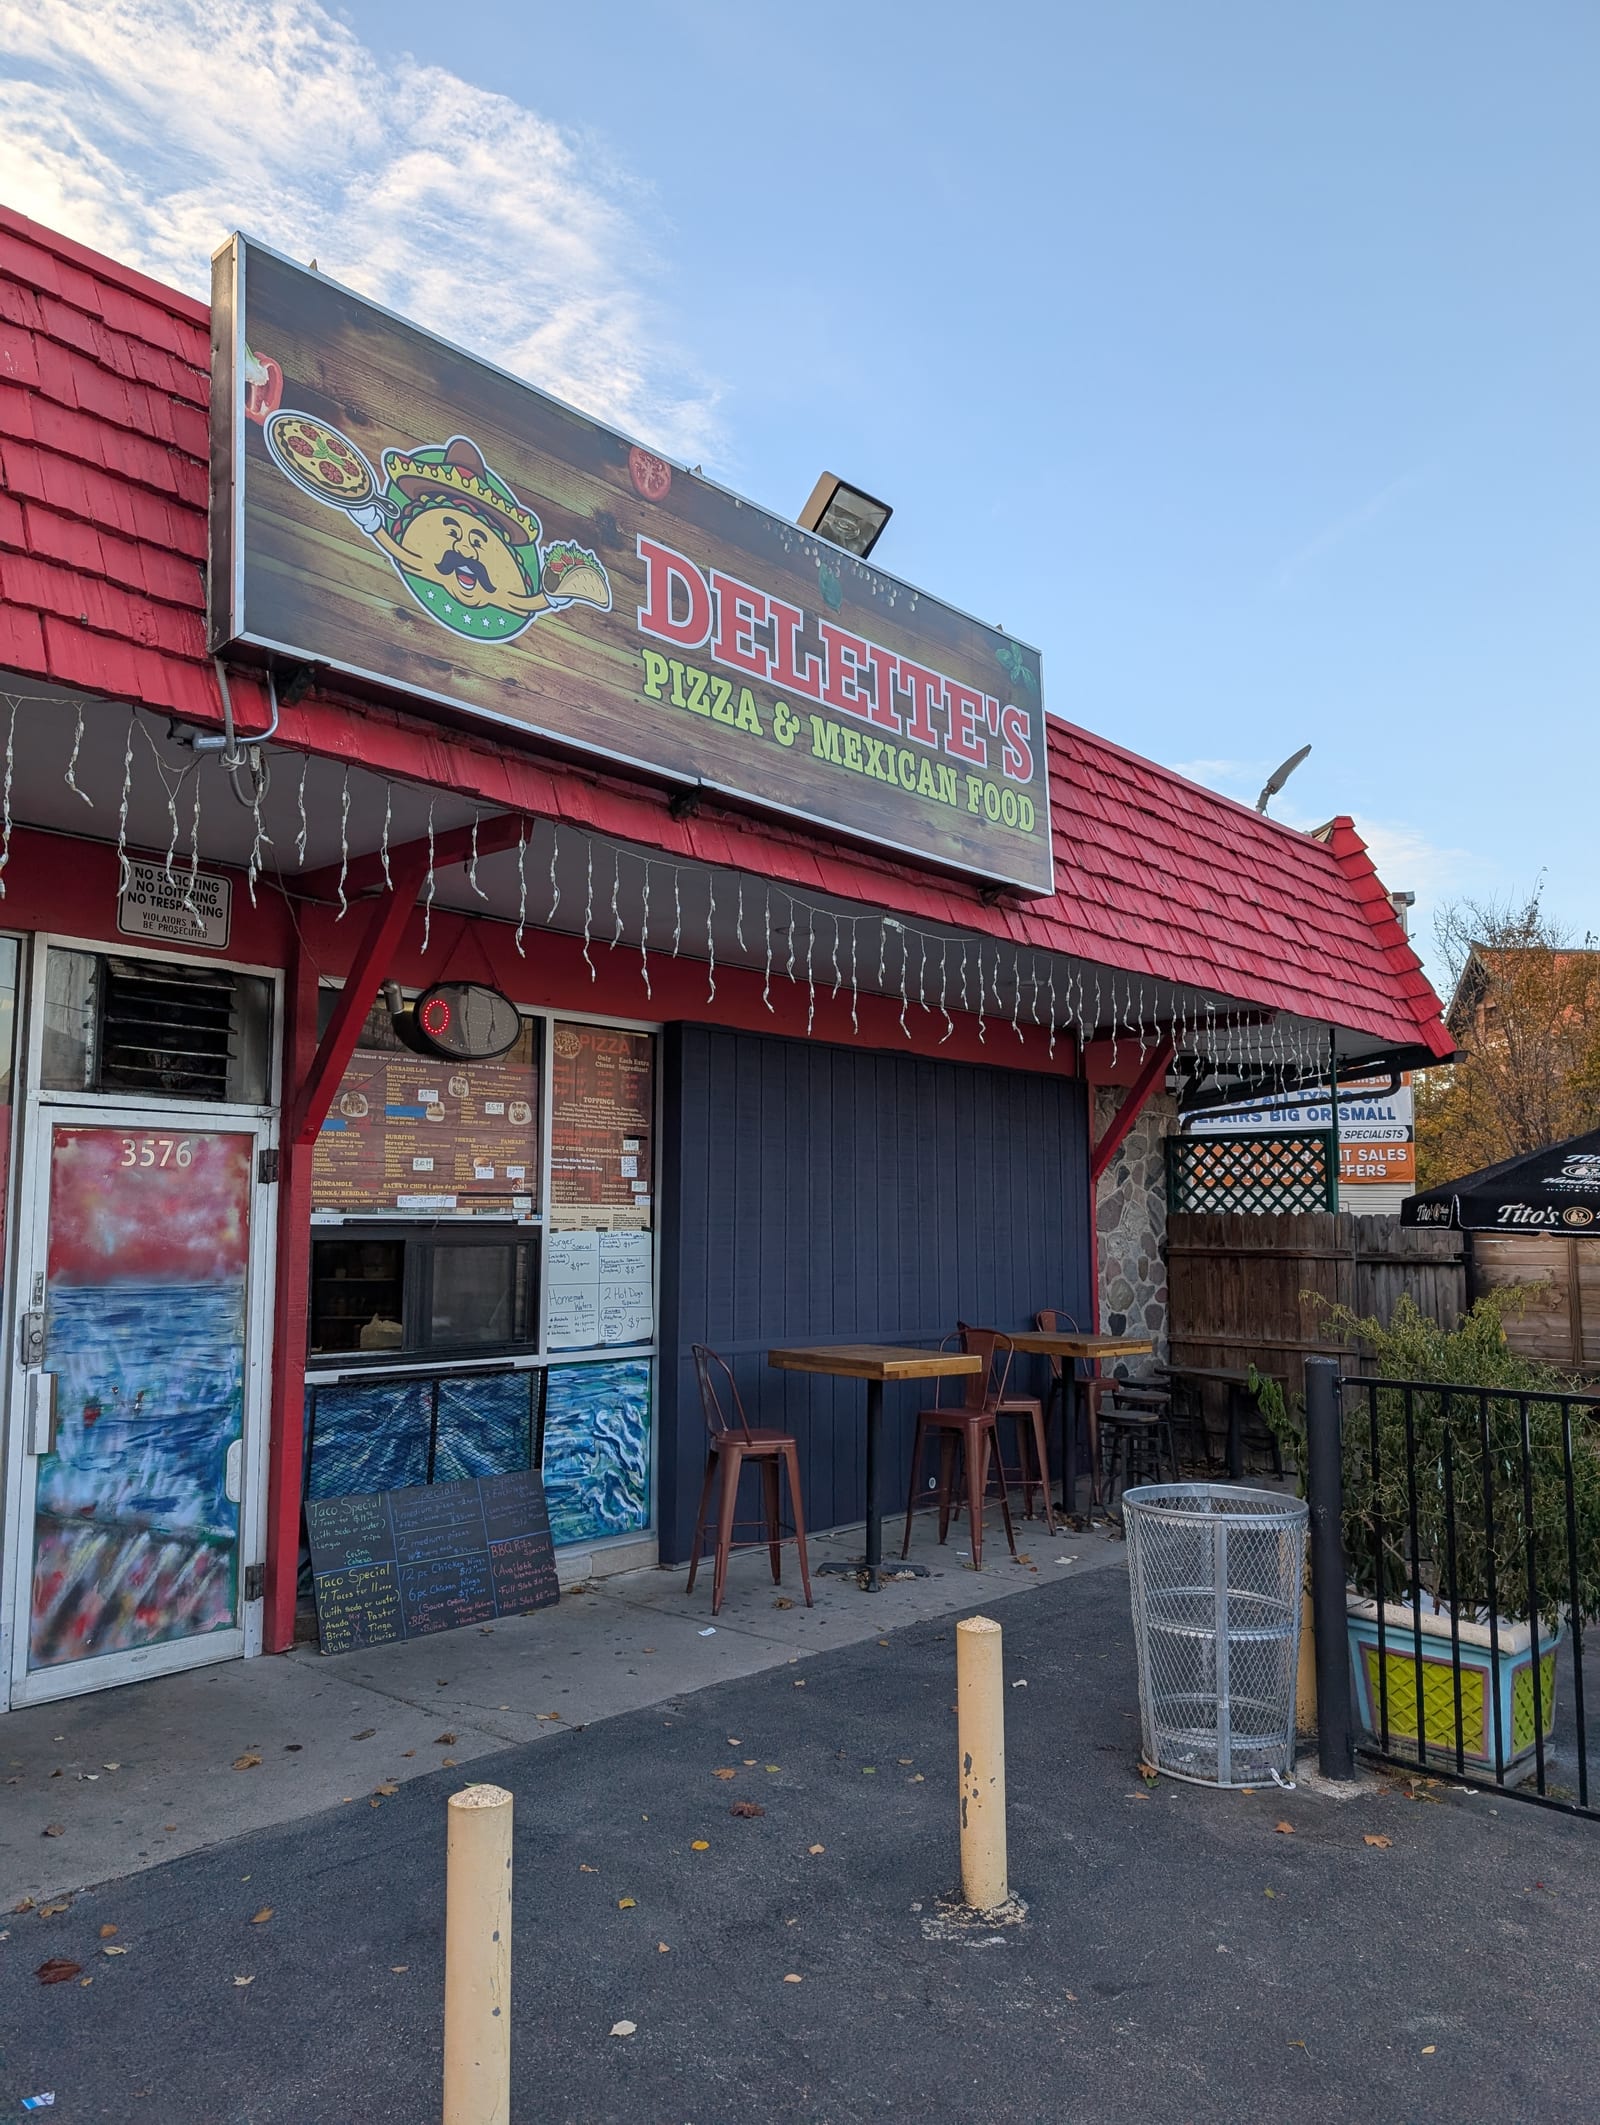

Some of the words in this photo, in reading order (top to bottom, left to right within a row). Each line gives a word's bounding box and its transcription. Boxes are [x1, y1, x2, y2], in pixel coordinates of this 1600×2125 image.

[637, 533, 1035, 784] DELEITE'S
[640, 648, 764, 737] PIZZA
[772, 701, 800, 747] &
[809, 713, 959, 808] MEXICAN
[965, 773, 1036, 833] FOOD
[135, 867, 153, 880] NO
[157, 871, 220, 893] SOLICTING
[136, 880, 154, 893] NO
[127, 892, 146, 904] NO
[143, 911, 186, 926] VIOLATORS
[191, 920, 208, 930] WL
[143, 920, 153, 929] BE
[158, 923, 207, 938] PROSECUTED
[580, 1034, 631, 1055] PIZZA
[583, 1096, 615, 1105] TOPPINGS
[1270, 1108, 1300, 1122] BIG
[1307, 1107, 1332, 1121] OR
[1339, 1106, 1396, 1121] SMALL
[1344, 1129, 1404, 1139] SPECIALISTS
[121, 1139, 192, 1167] 3576
[1358, 1148, 1407, 1161] SALES
[1497, 1203, 1559, 1224] Tito's
[604, 1287, 611, 1300] 2
[311, 1502, 338, 1517] Taco
[341, 1493, 381, 1515] Special
[490, 1542, 513, 1558] BBQ
[316, 1575, 343, 1589] Taco
[348, 1562, 390, 1585] Special
[320, 1592, 327, 1603] 4
[331, 1589, 353, 1600] Tacos
[367, 1608, 396, 1621] Pastor
[326, 1630, 351, 1640] Birria
[368, 1622, 392, 1631] Tinga
[328, 1641, 350, 1652] Pollo
